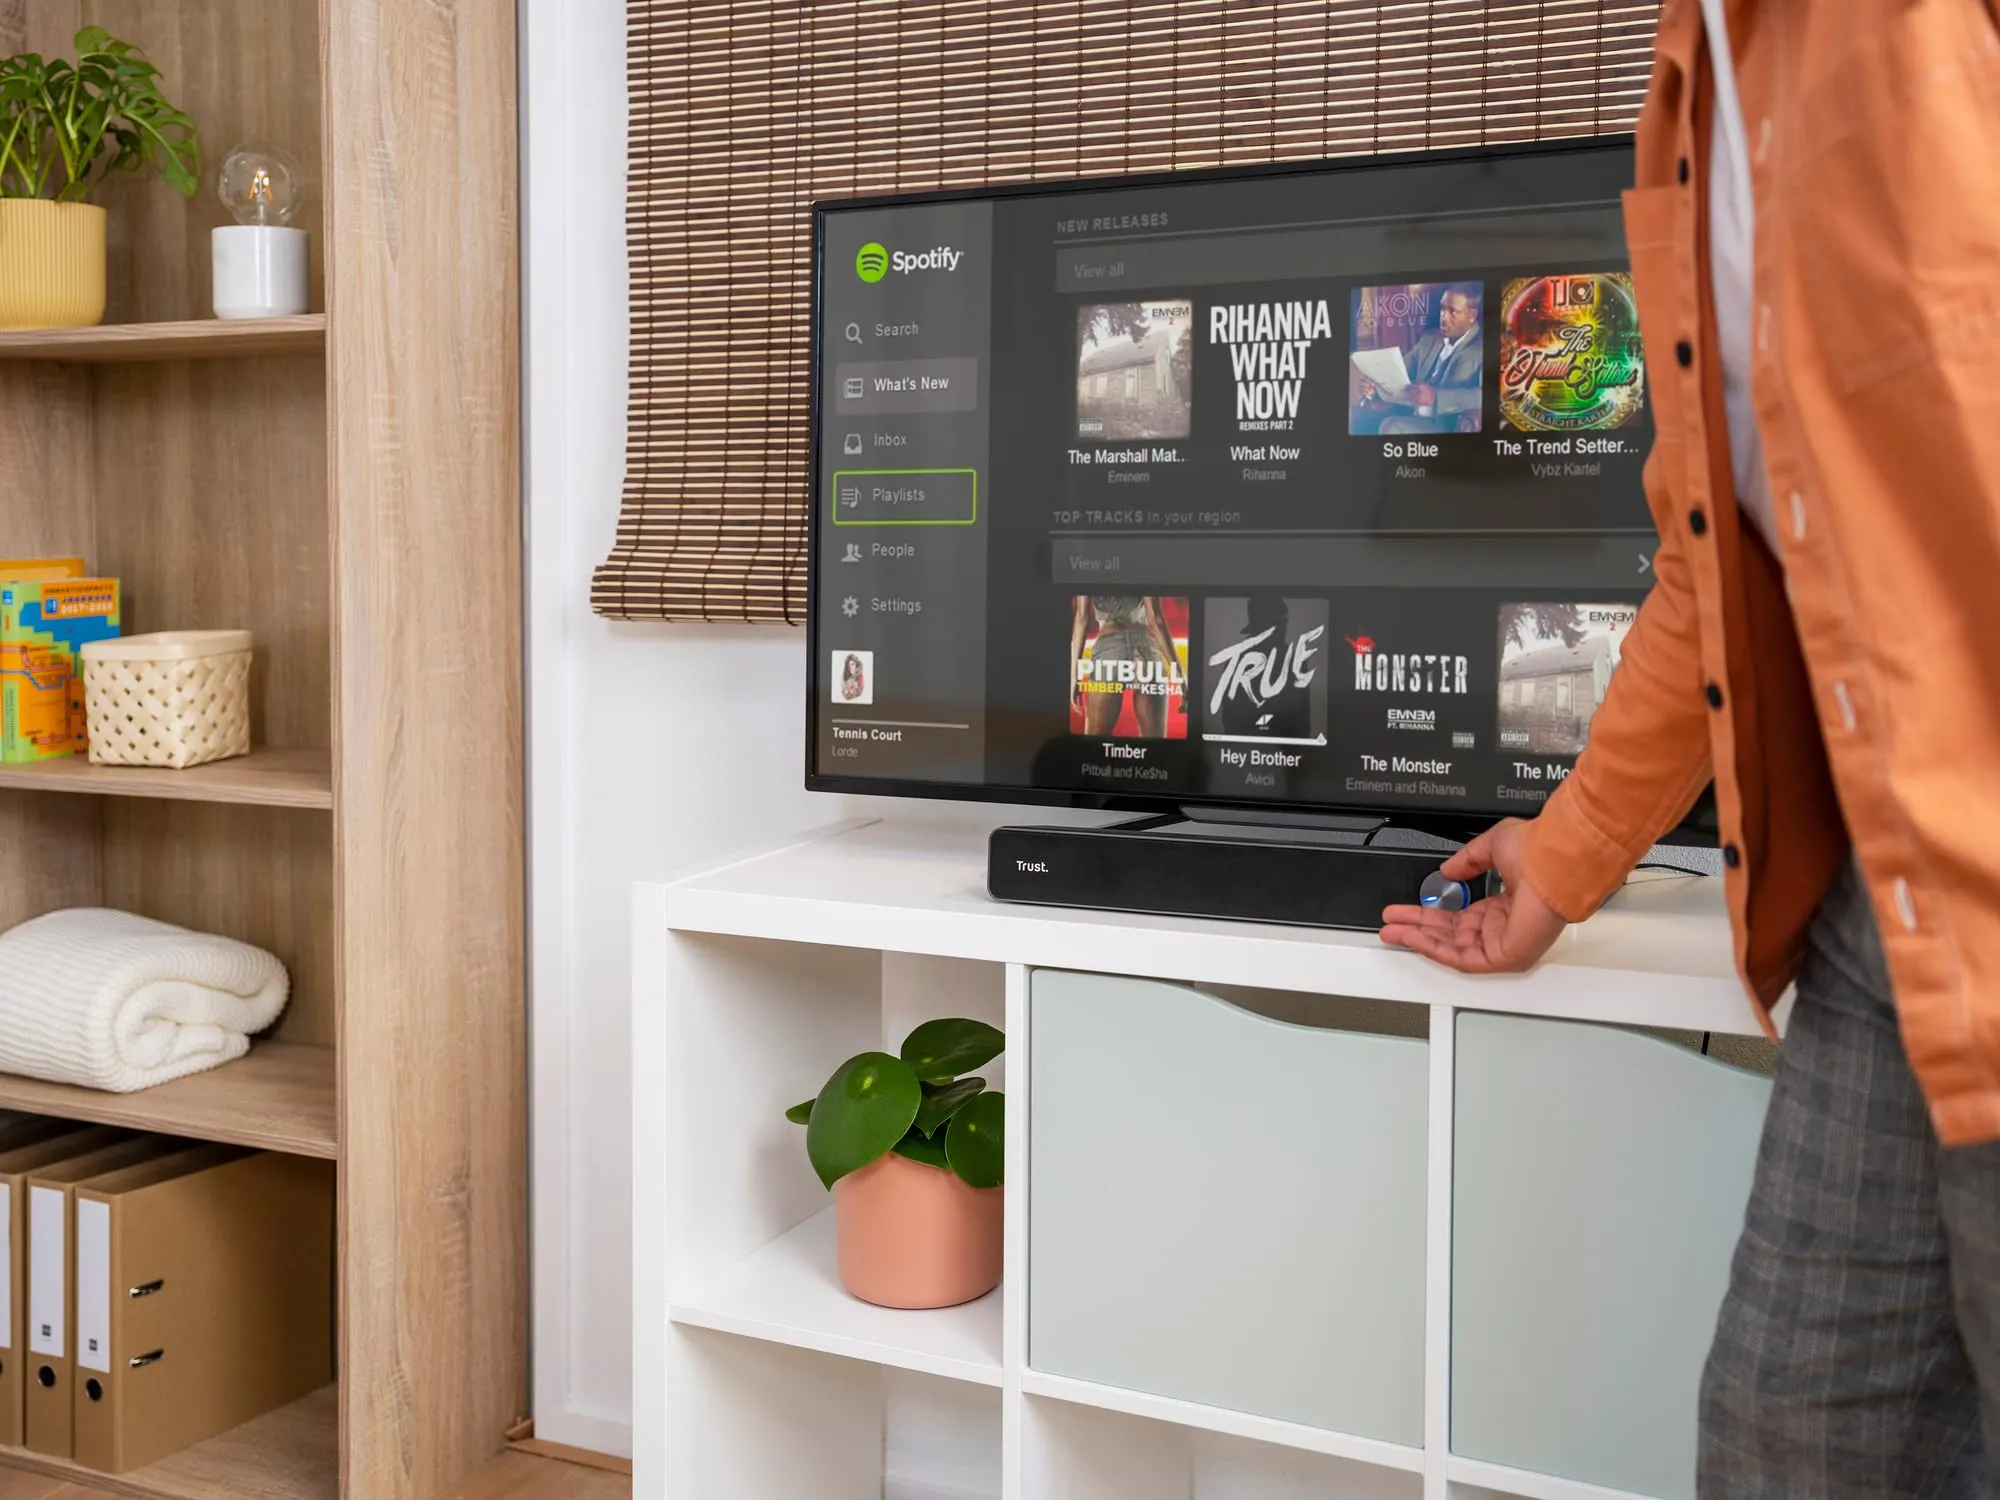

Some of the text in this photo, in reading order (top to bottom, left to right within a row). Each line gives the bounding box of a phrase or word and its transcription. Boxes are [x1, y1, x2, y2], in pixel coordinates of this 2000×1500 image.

[1057, 213, 1169, 233] NEW RELEASES
[892, 246, 961, 275] Spotify
[1074, 262, 1124, 279] View all
[1356, 292, 1430, 318] AKON
[874, 321, 919, 337] Search
[1210, 300, 1332, 344] RIHANNA
[1387, 316, 1428, 327] BLUE
[1558, 323, 1594, 356] The
[1230, 340, 1312, 381] WHAT
[873, 376, 949, 392] What's New
[1236, 379, 1303, 420] NOW
[1239, 420, 1294, 431] REMIXES PART 2
[873, 433, 908, 447] Inbox
[1493, 437, 1639, 455] The Trend Setter...
[1067, 449, 1092, 464] The
[1095, 448, 1149, 464] Marshall
[1230, 445, 1300, 461] What Now
[1383, 442, 1439, 458] So Blue
[1108, 470, 1150, 484] Eminem
[1242, 467, 1286, 481] Rihanna
[1394, 465, 1426, 479] Akon
[1531, 461, 1601, 477] Vybz Kartel
[872, 488, 925, 504] Playlists
[1053, 510, 1081, 523] TOP
[1086, 510, 1144, 523] TRACKS
[1163, 512, 1194, 527] your
[1198, 511, 1241, 527] region
[871, 542, 915, 559] People
[1069, 556, 1120, 571] View all
[870, 598, 922, 615] Settings
[1077, 659, 1184, 684] PITBULL
[1208, 625, 1325, 715] TRUE
[1355, 653, 1468, 694] MONSTER
[1076, 681, 1124, 695] TIMBER
[832, 727, 902, 742] Tennis Court
[832, 746, 859, 758] Lorde
[1102, 742, 1148, 759] Timber
[1220, 748, 1302, 768] Hey Brother
[1081, 763, 1112, 777] Pitbull
[1113, 765, 1133, 778] and
[1360, 755, 1452, 775] The Monster
[1513, 761, 1573, 780] The Mo
[1245, 772, 1275, 786] Avicii
[1345, 777, 1467, 797] Eminem and Rihanna
[1496, 785, 1547, 801] Eminem
[1016, 860, 1049, 873] Trust.
